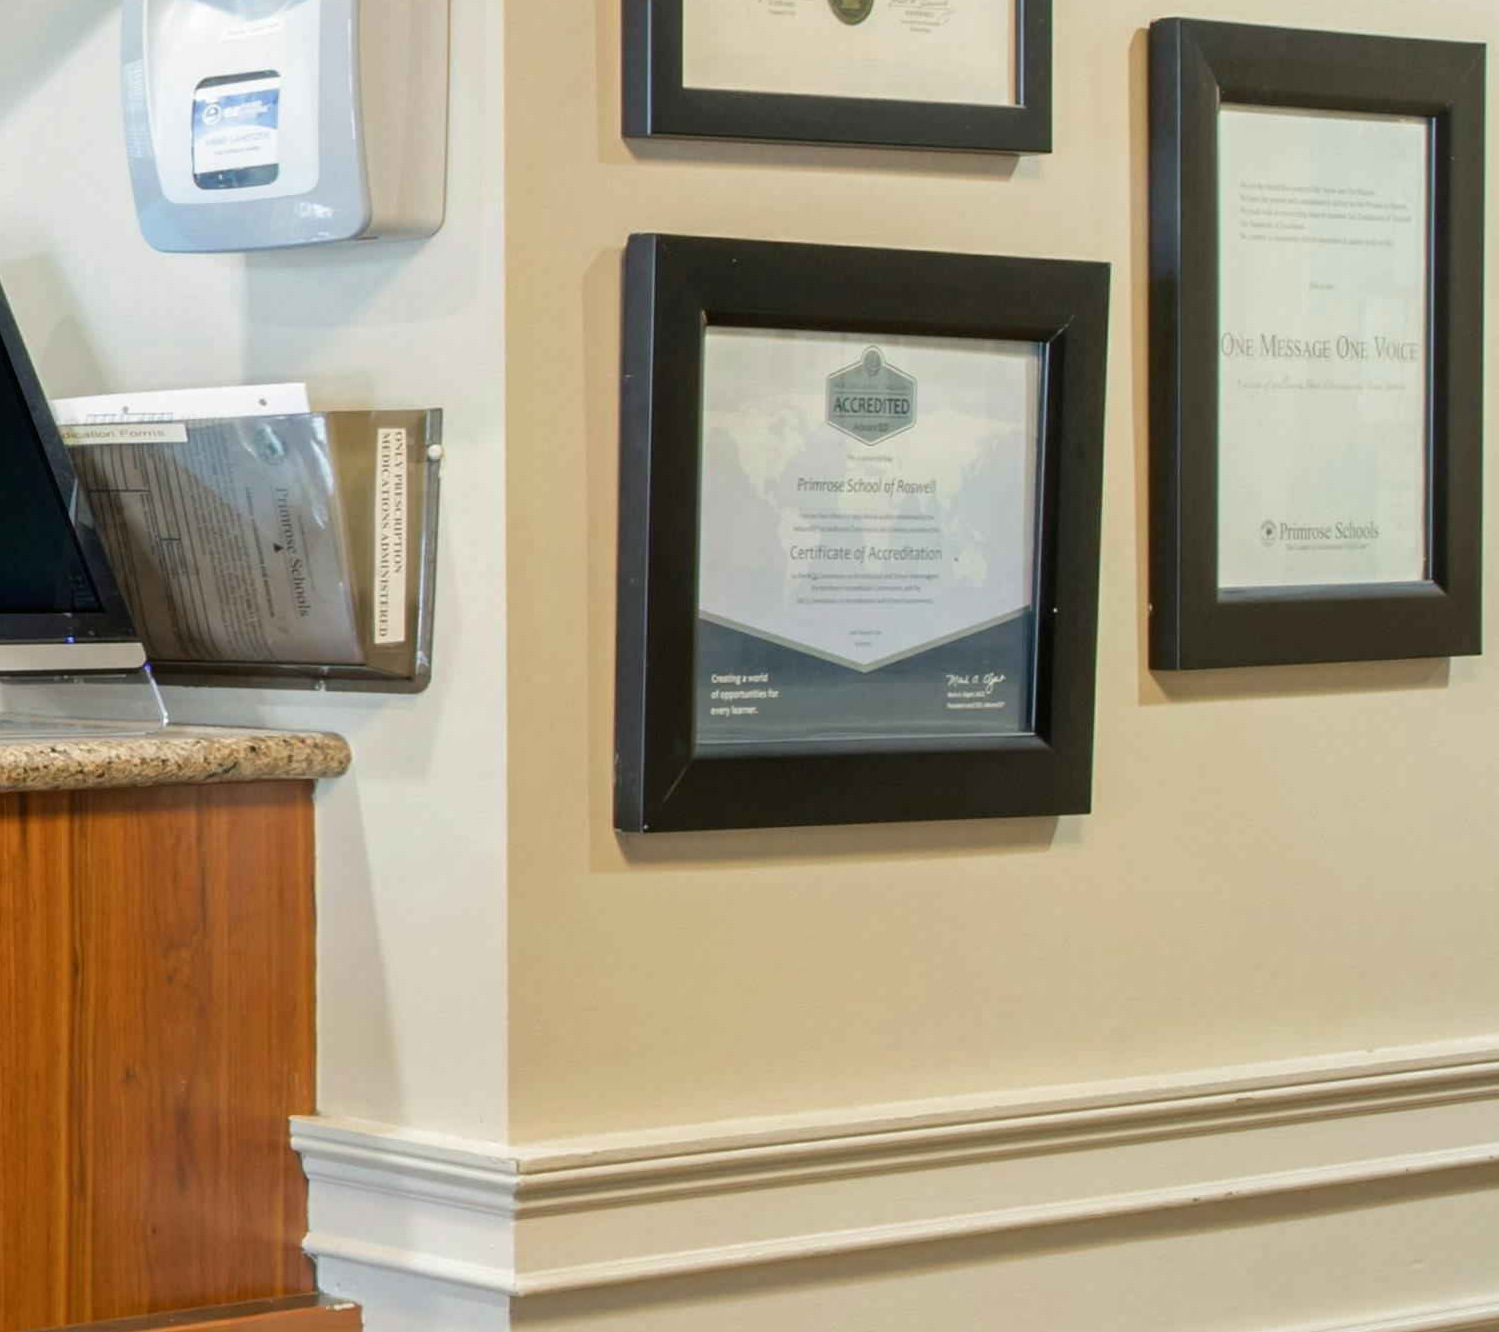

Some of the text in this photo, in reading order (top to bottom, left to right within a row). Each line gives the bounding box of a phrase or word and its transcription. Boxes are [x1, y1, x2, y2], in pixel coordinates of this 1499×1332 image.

[1221, 332, 1419, 360] ONE MESSAGE ONE VOICE
[832, 396, 910, 415] ACCREDITED
[62, 429, 166, 440] dication Forms
[797, 477, 936, 496] Primrose School of Roswell
[393, 431, 404, 574] ONLY PRESCRIPTION
[379, 432, 391, 637] MEDICATIONS ADMINISTERED
[1280, 520, 1379, 540] Primrose Schools
[275, 488, 297, 555] Primrose
[288, 559, 311, 617] Schools
[790, 544, 942, 564] Certificate of Accreditation
[711, 673, 741, 685] Creating
[748, 673, 768, 683] world
[710, 688, 780, 701] of opportunities for
[710, 707, 730, 717] every
